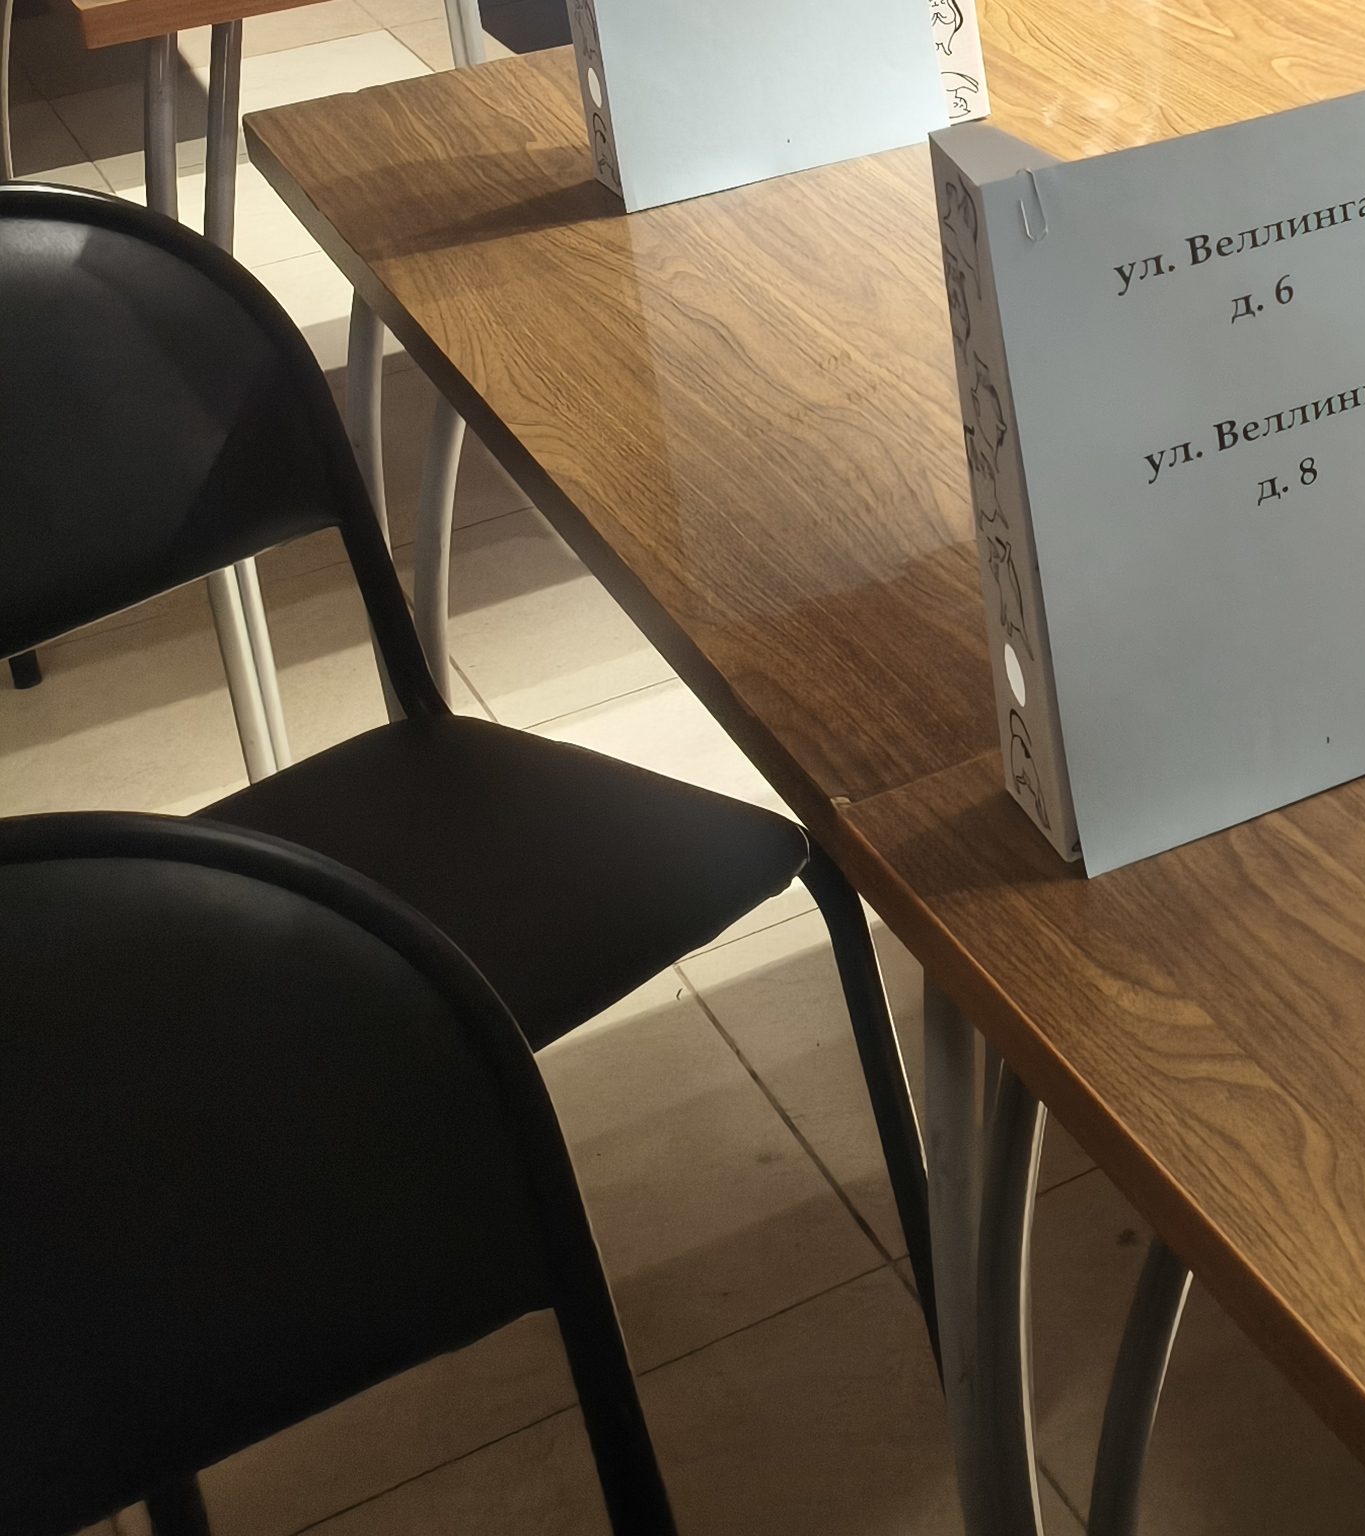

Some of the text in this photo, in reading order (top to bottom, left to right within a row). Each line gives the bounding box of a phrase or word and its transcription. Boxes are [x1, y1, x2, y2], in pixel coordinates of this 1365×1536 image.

[1113, 254, 1176, 297] ул.
[1231, 274, 1294, 325] д. 6
[1143, 441, 1203, 485] ул.
[1257, 456, 1318, 507] д. 8
